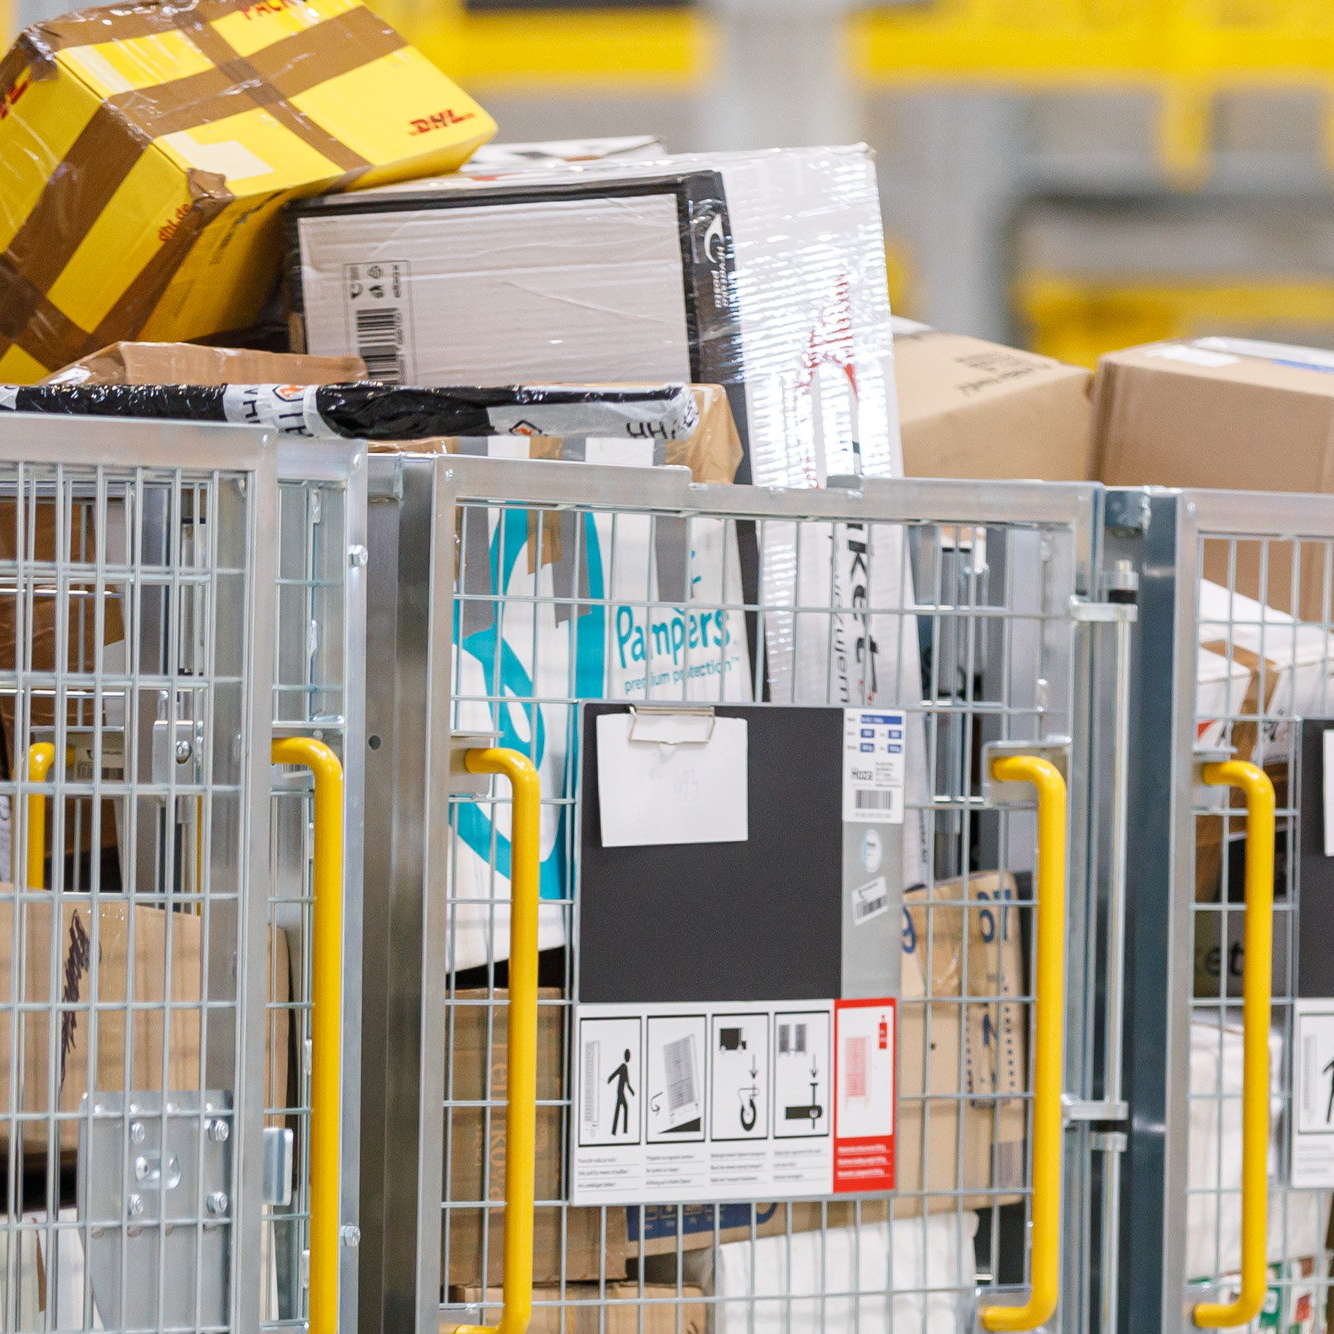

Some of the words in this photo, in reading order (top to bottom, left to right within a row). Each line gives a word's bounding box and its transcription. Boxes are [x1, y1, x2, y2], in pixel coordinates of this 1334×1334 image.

[409, 109, 475, 136] DHL
[157, 202, 191, 242] dhl.de
[616, 604, 731, 669] Pampers
